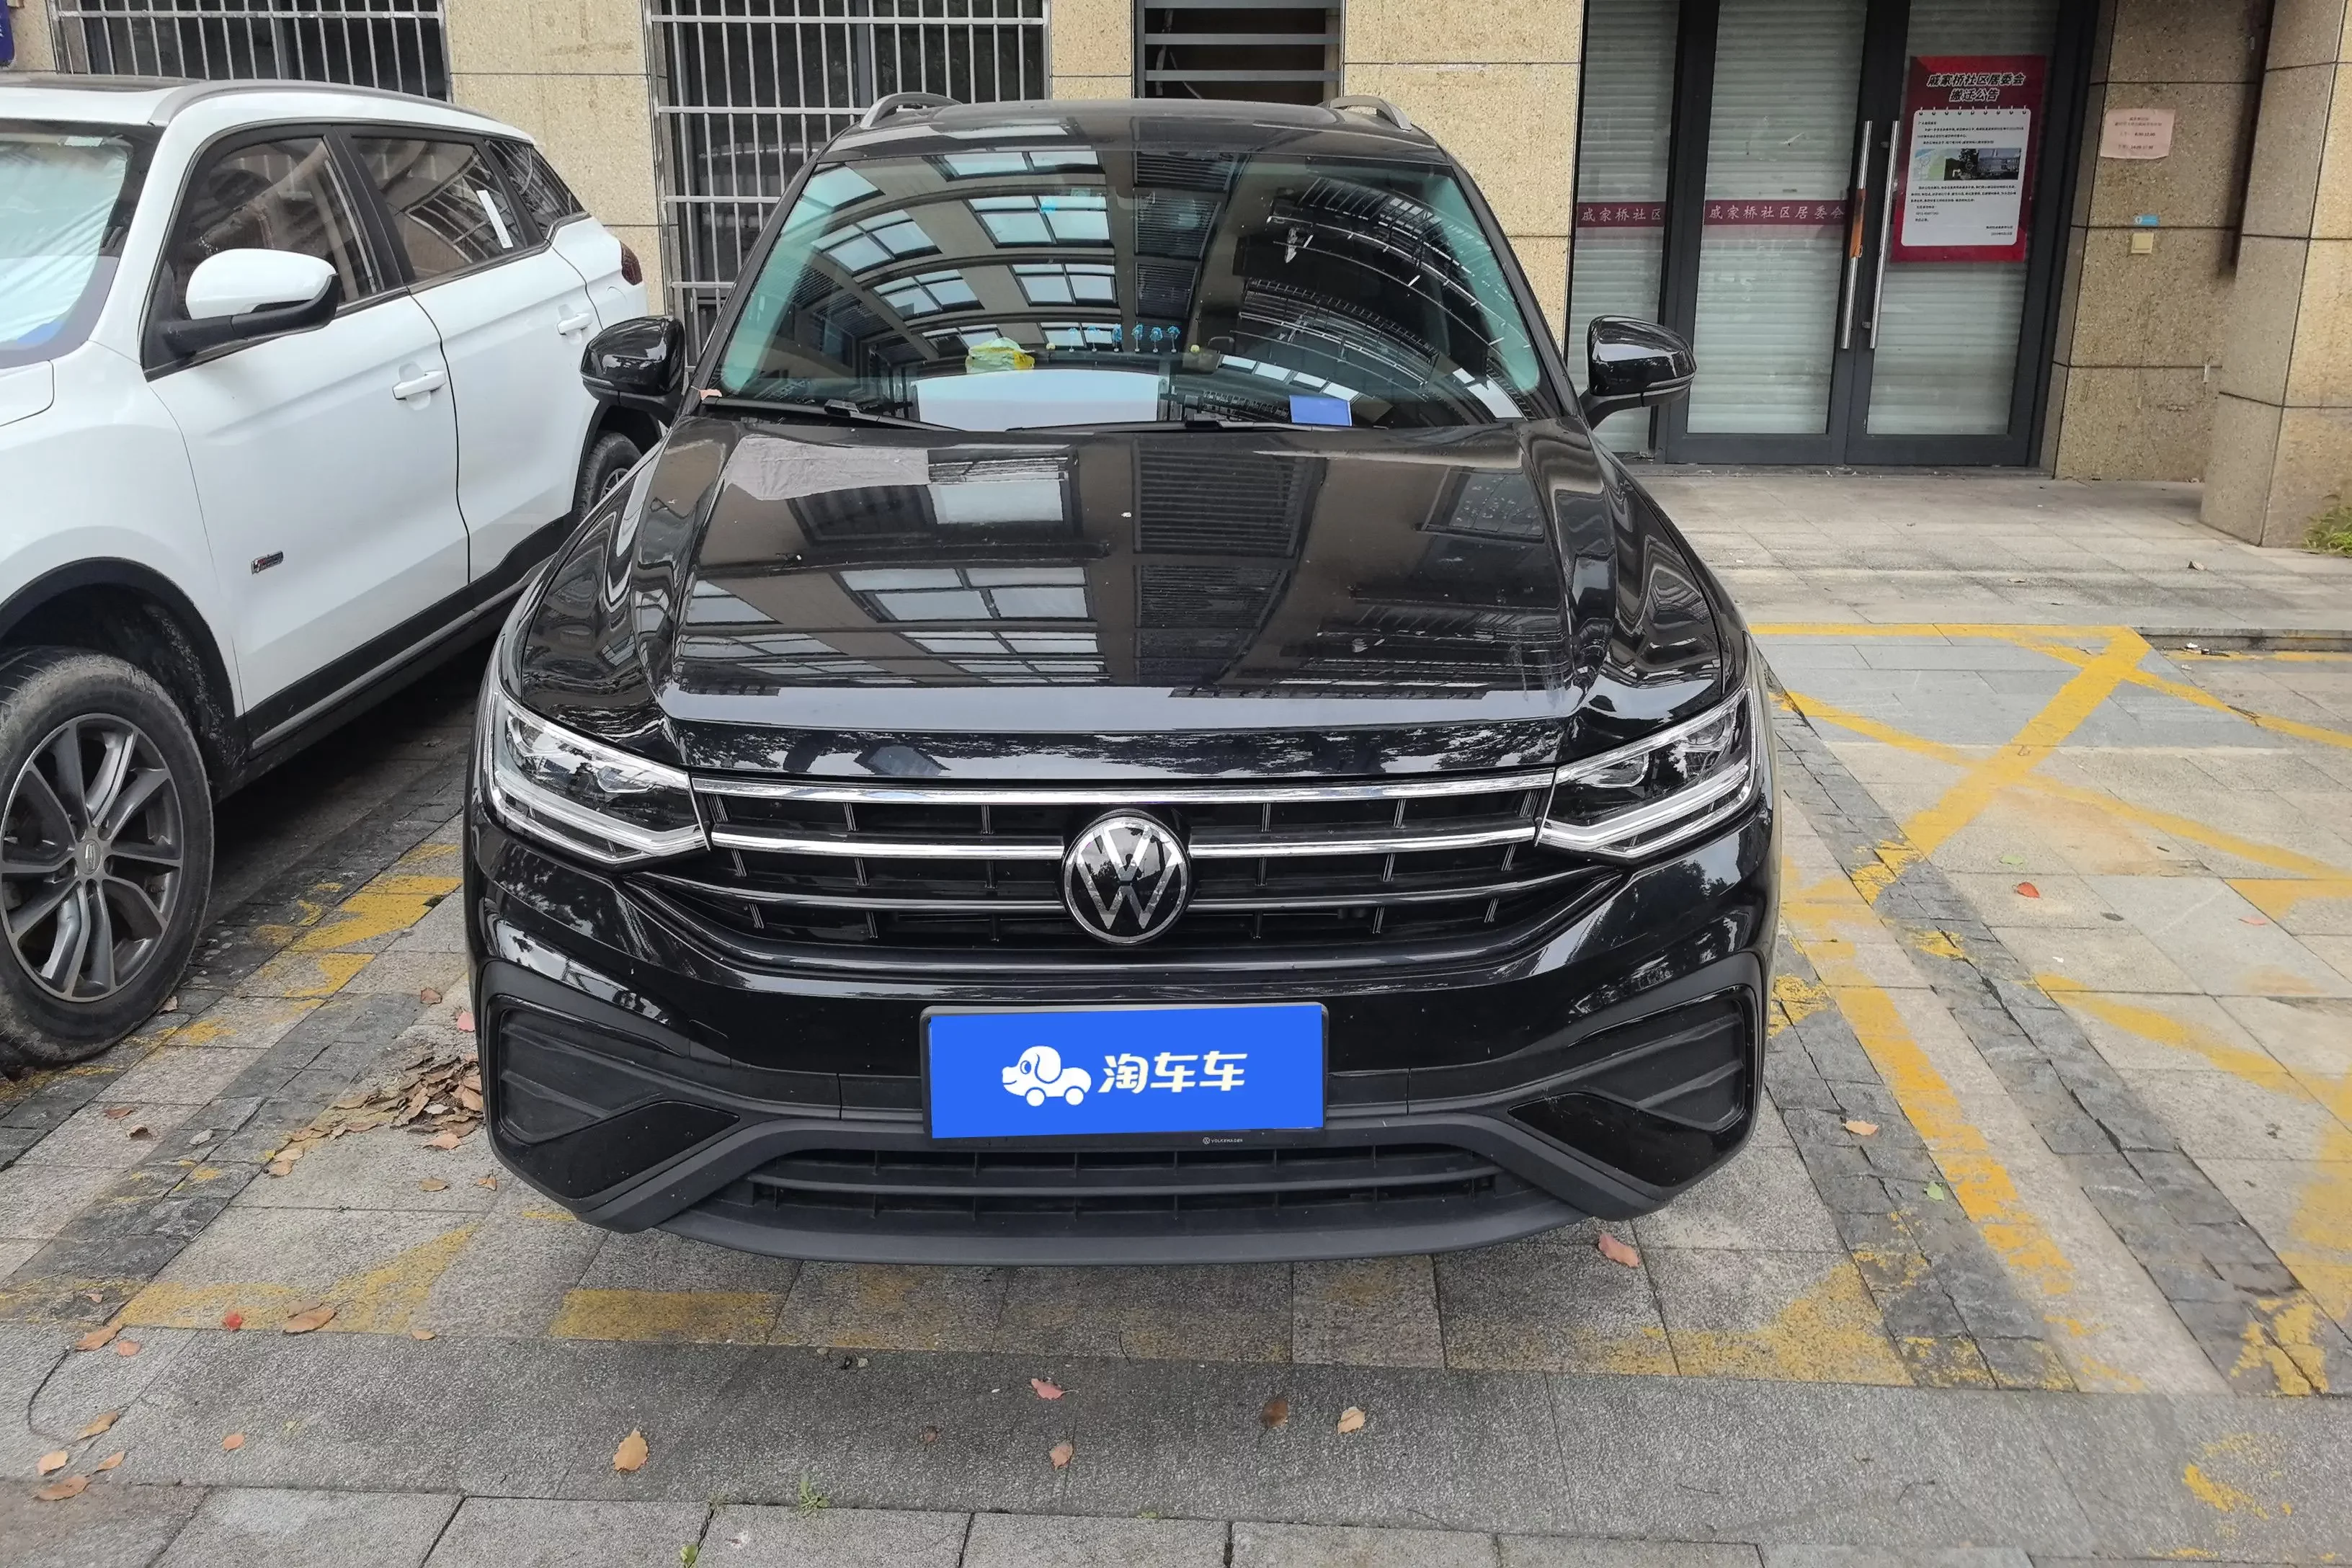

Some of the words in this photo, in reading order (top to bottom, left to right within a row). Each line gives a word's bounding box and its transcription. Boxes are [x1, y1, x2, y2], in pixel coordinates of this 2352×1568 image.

[1927, 73, 2026, 86] 戚家桥社区居委会
[1949, 88, 2000, 102] 搬迁公告
[1582, 208, 1661, 222] 戚家桥社区
[1709, 205, 1845, 219] 戚家桥社区居委会
[1074, 819, 1183, 931] VW
